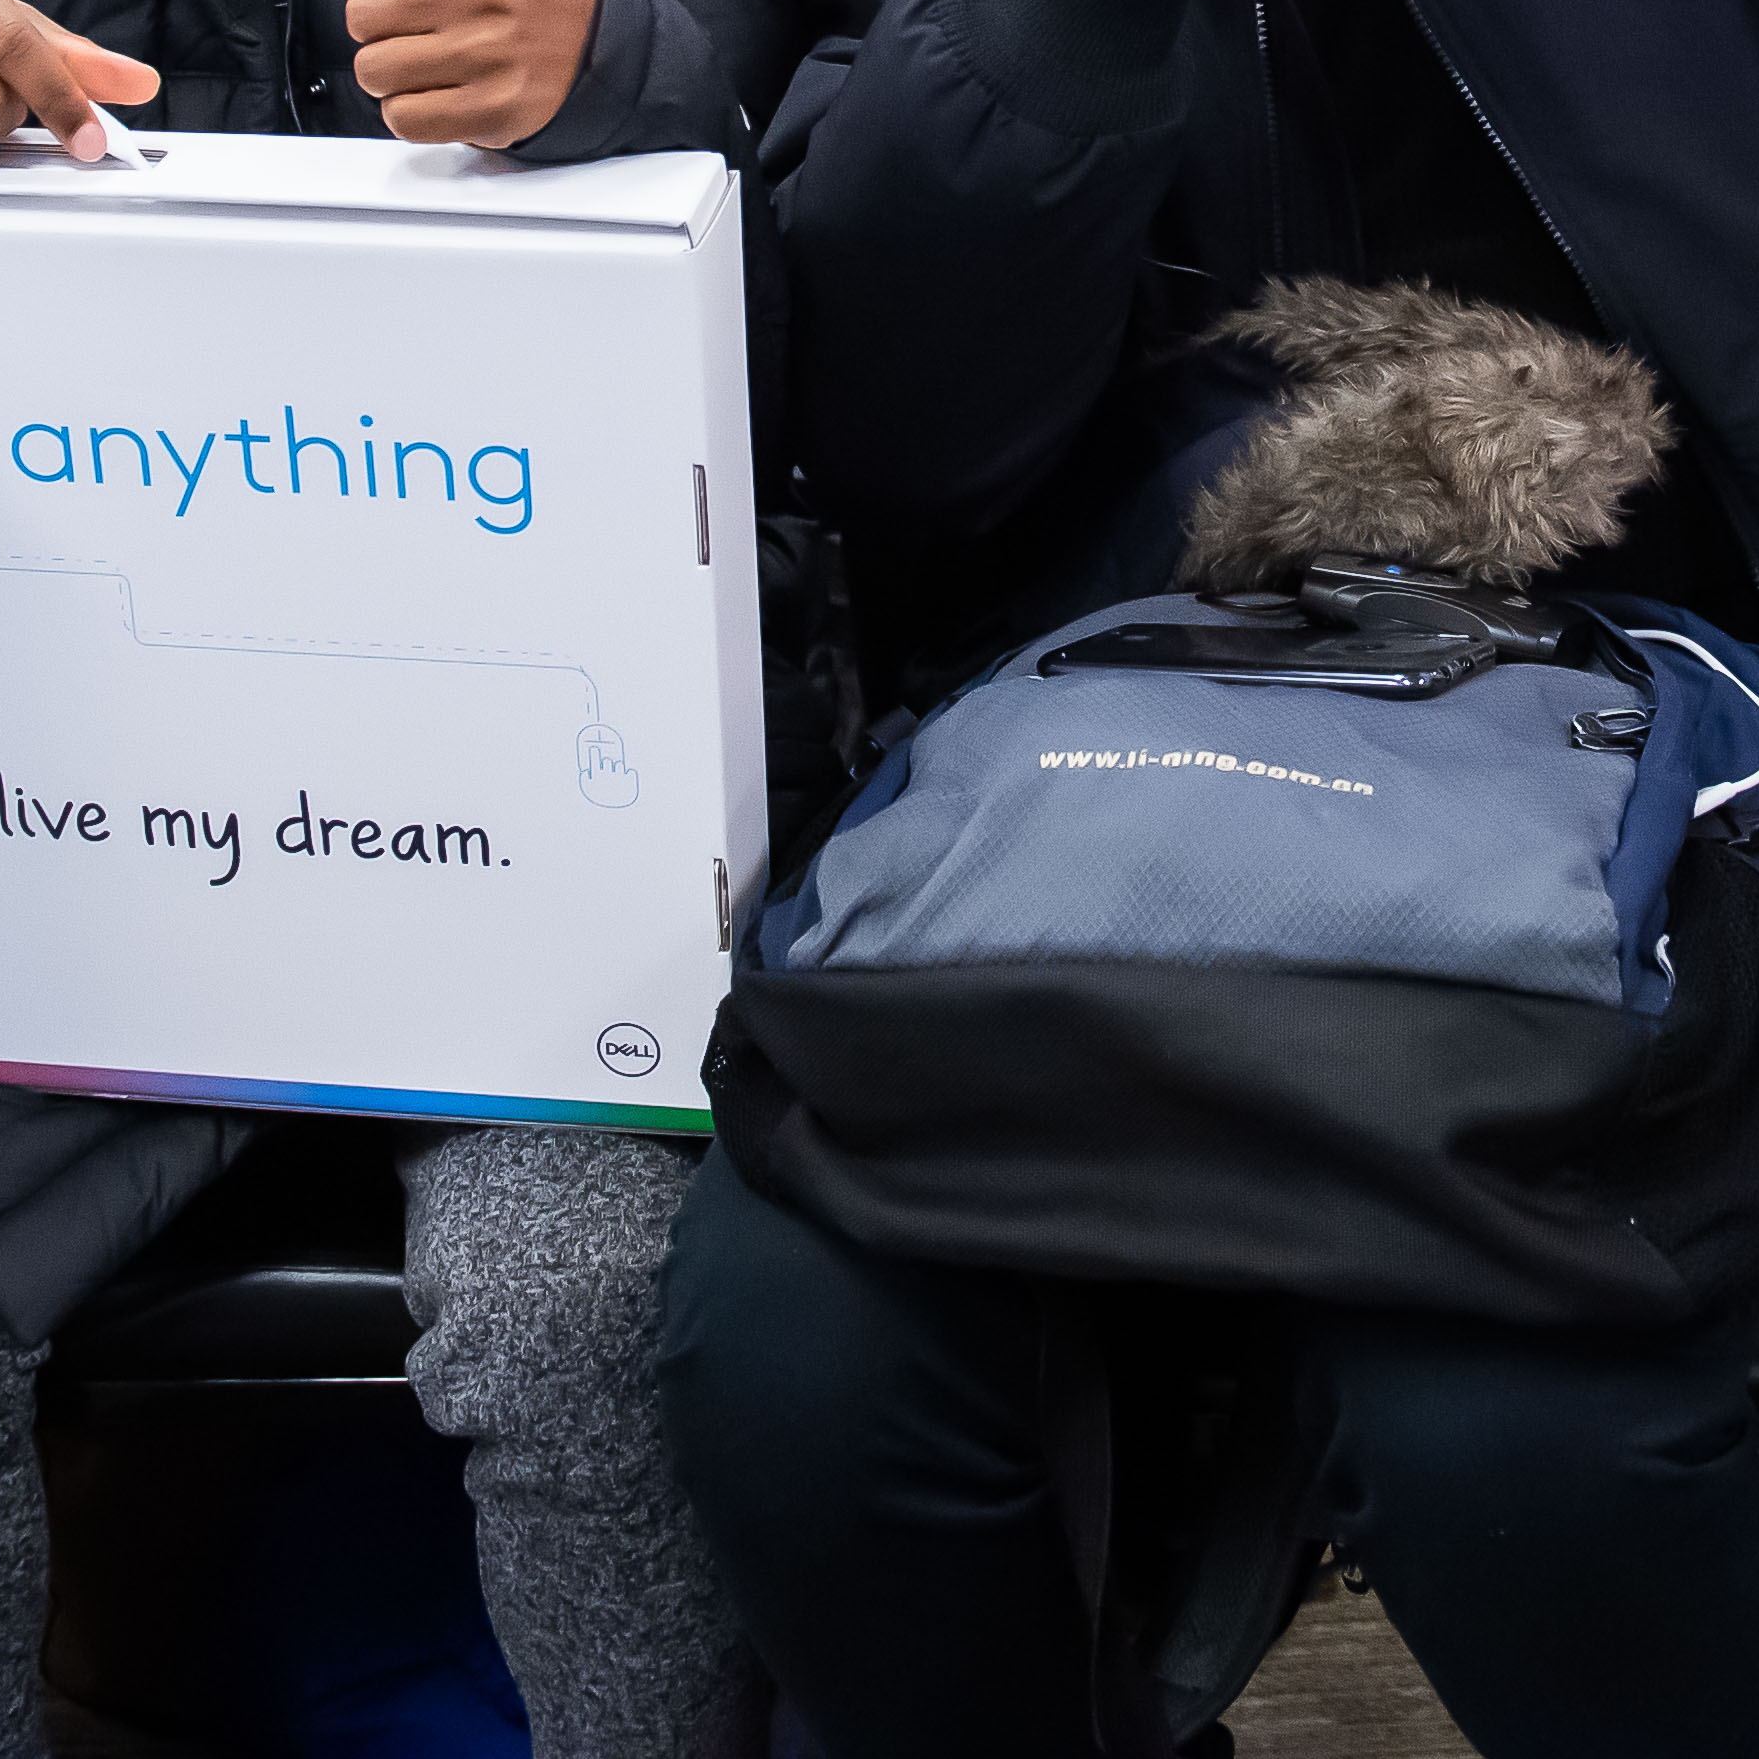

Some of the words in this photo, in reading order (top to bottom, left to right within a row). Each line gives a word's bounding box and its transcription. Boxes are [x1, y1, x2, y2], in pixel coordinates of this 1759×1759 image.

[12, 406, 532, 534] anything
[142, 806, 240, 886] my
[276, 790, 510, 866] dream.
[606, 1042, 655, 1059] DELL
